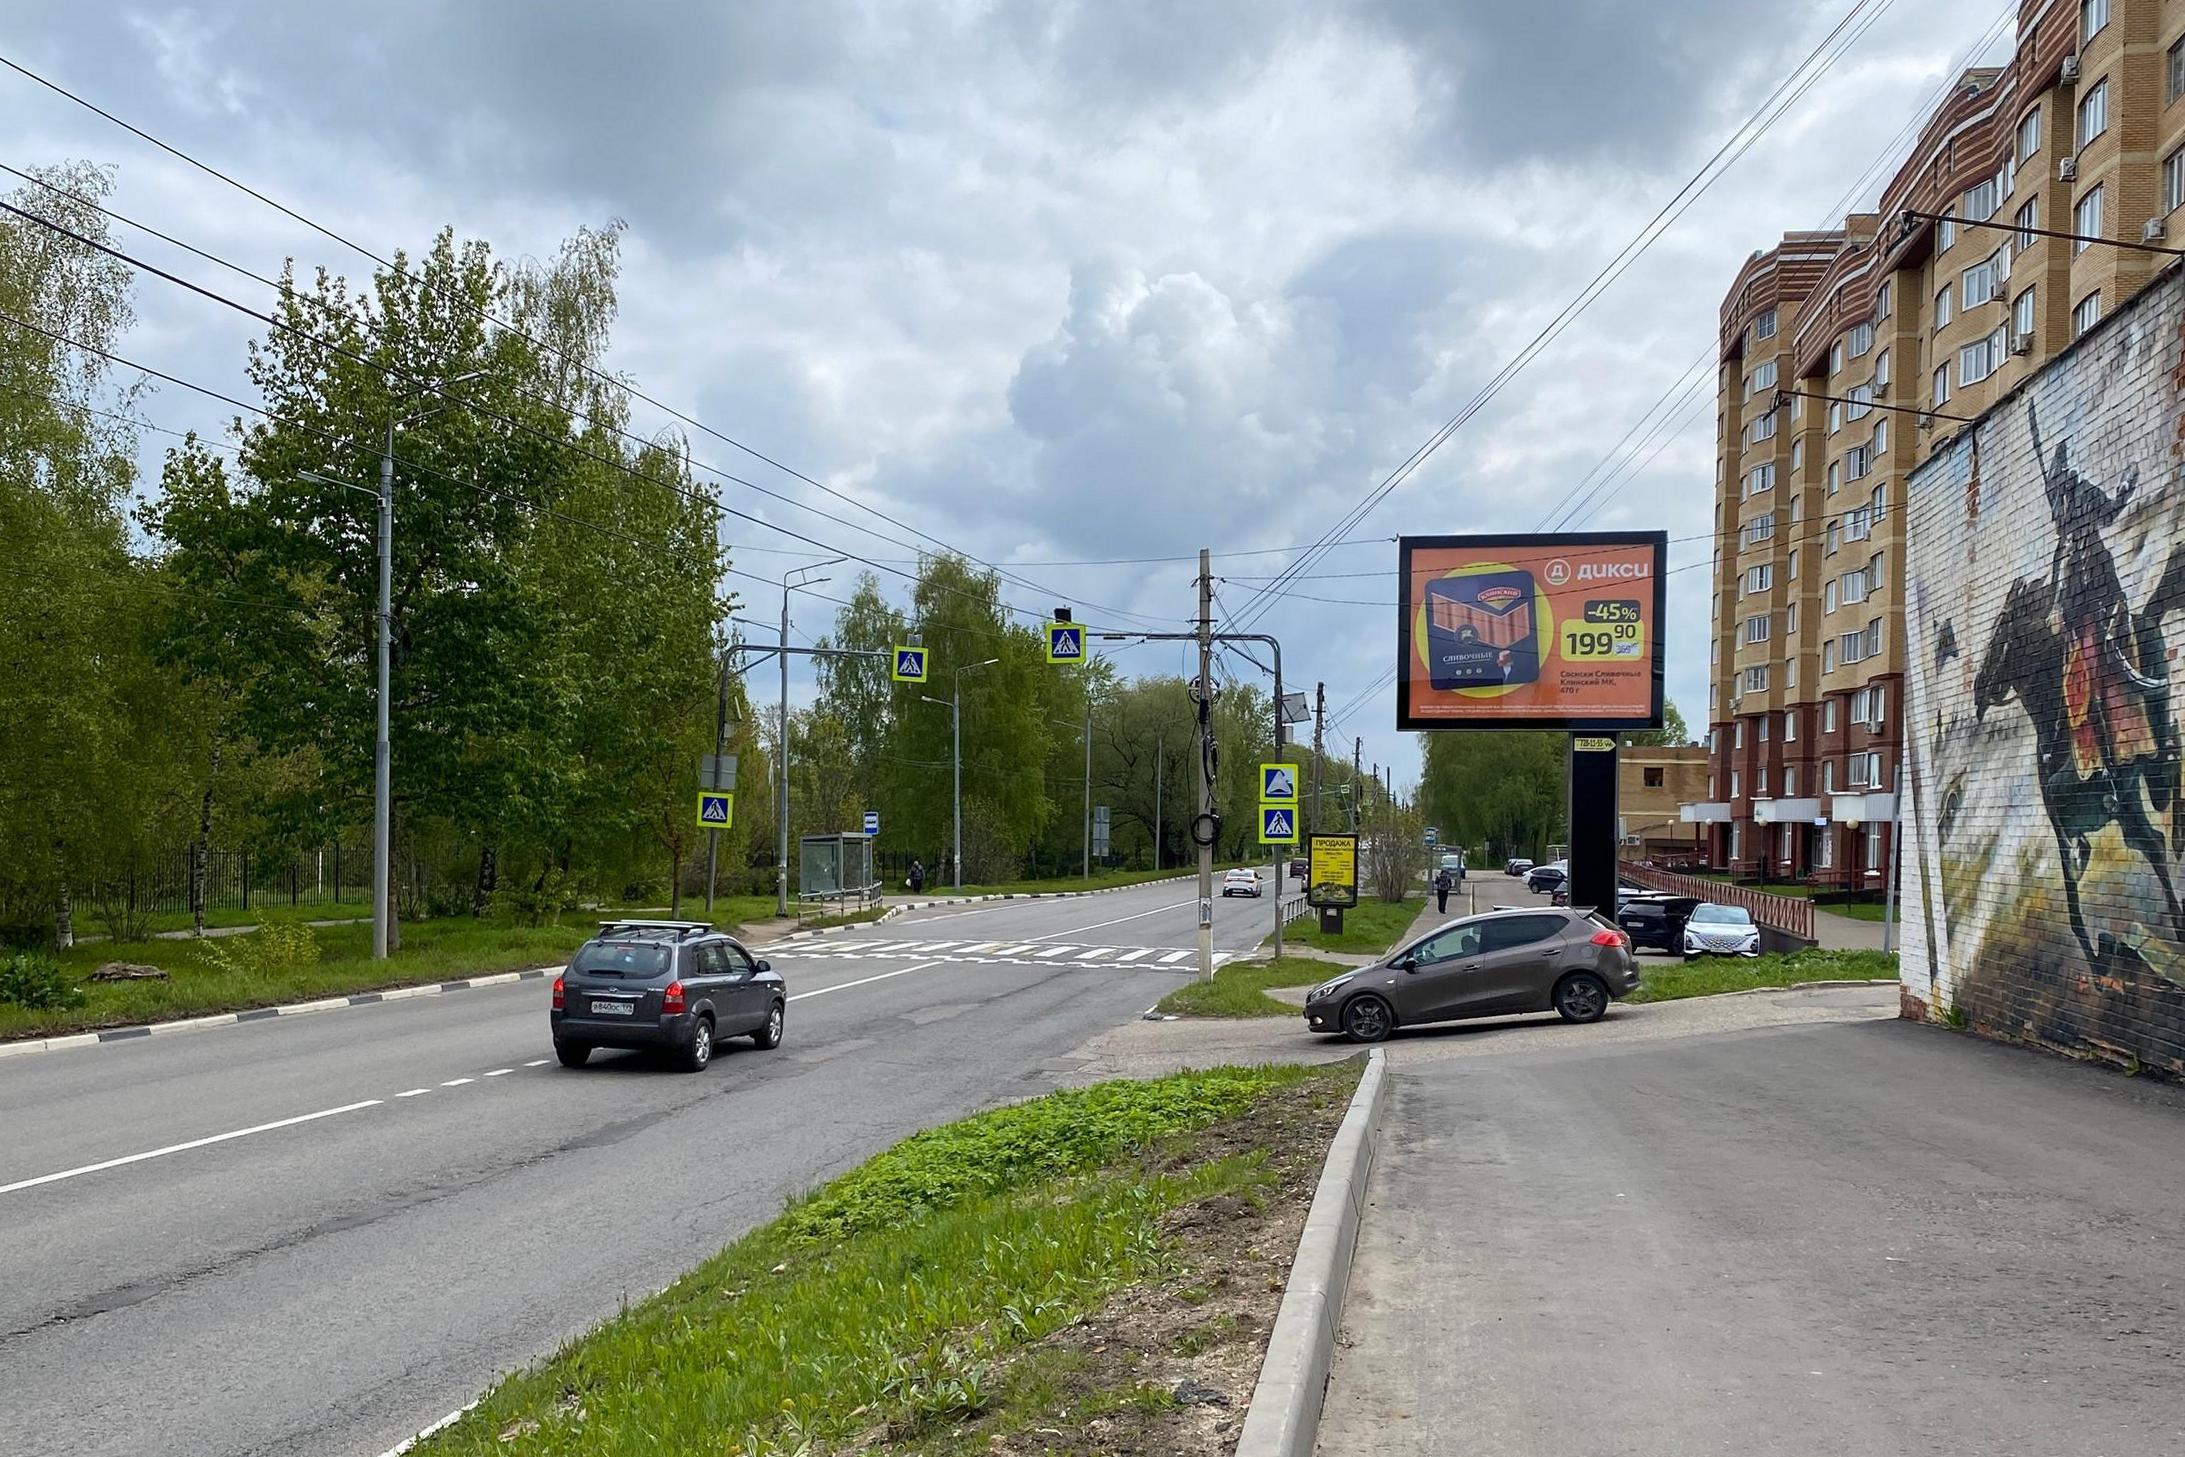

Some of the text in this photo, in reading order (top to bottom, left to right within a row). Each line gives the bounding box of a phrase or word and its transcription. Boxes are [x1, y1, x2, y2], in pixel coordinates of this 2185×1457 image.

[1587, 603, 1637, 620] -45%
[1566, 632, 1613, 655] 199
[1614, 624, 1636, 639] 90
[1315, 839, 1351, 847] ПРОДАЖА
